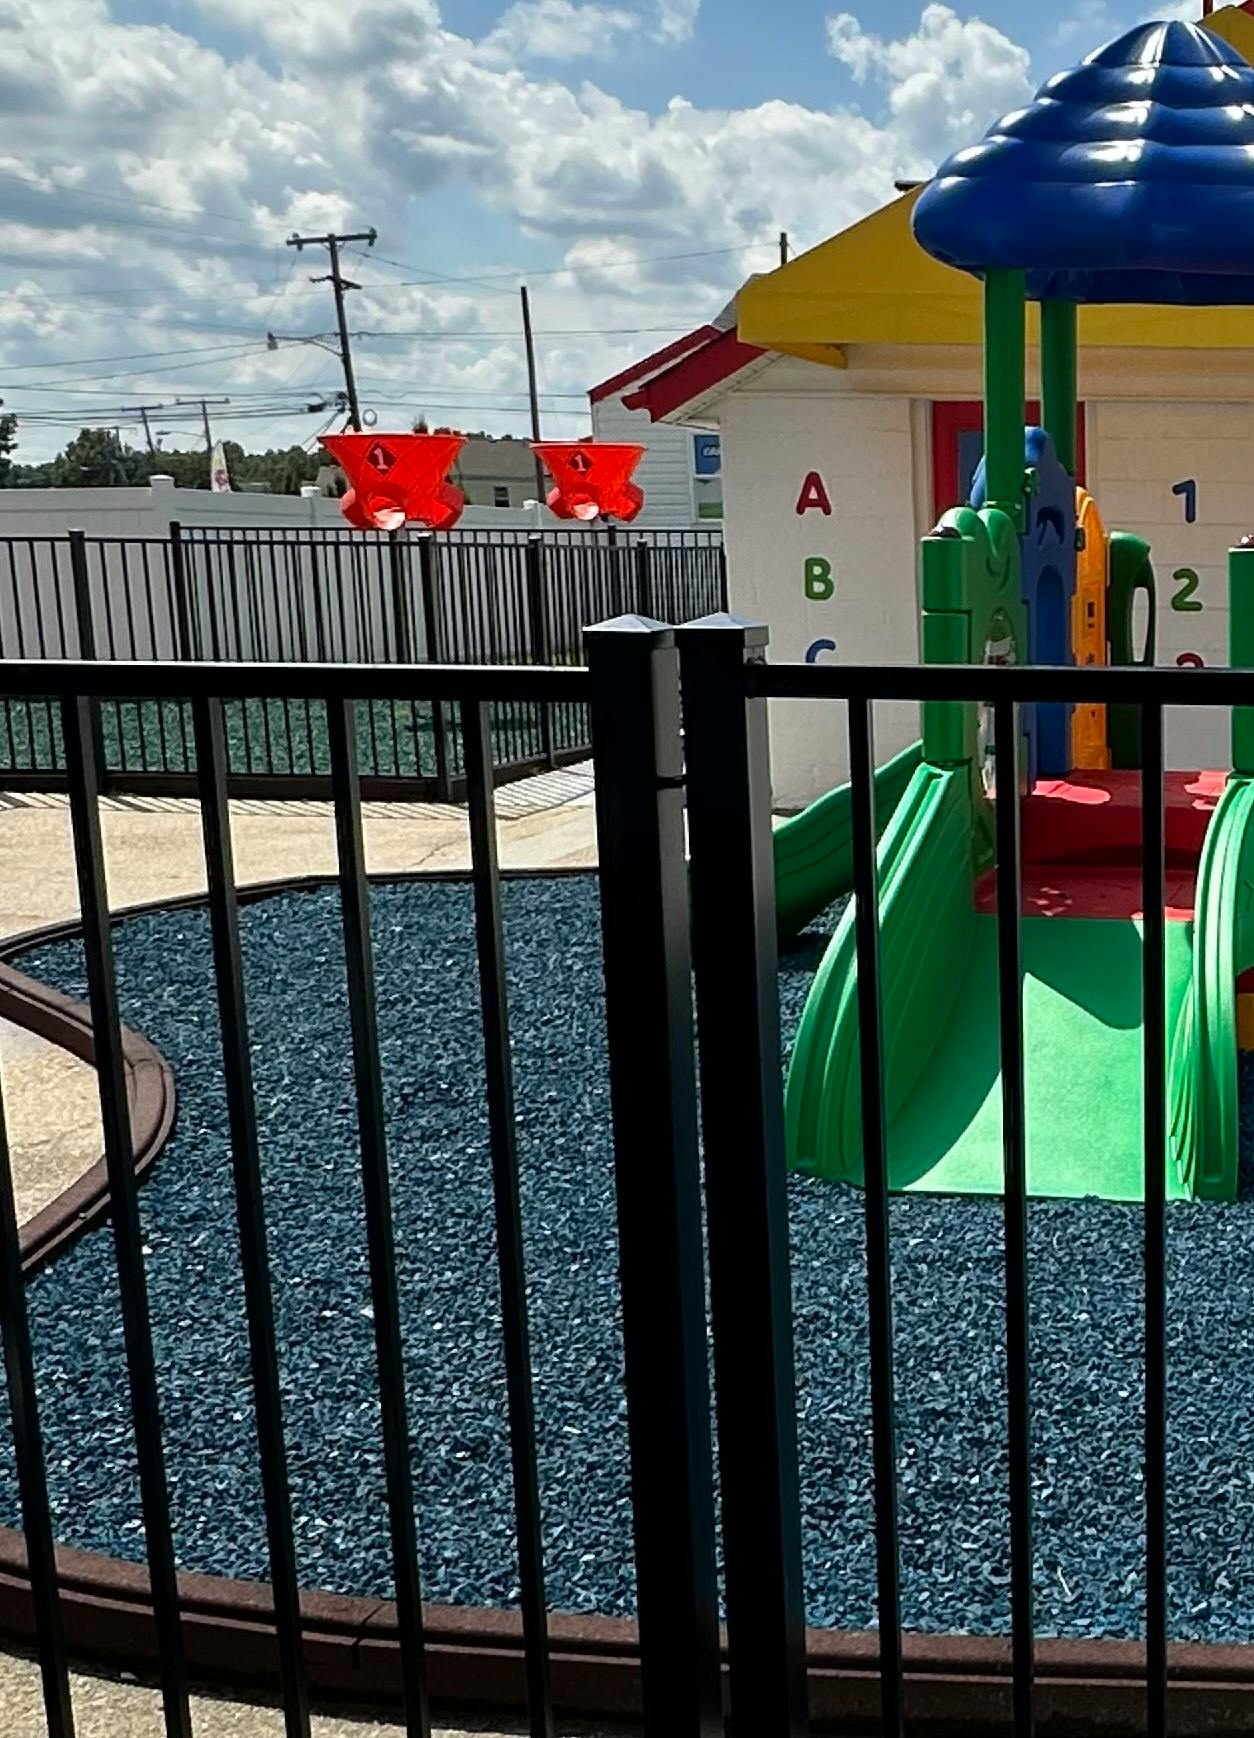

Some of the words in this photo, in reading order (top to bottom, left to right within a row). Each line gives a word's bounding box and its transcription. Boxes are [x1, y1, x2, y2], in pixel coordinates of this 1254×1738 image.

[374, 448, 388, 469] 1
[575, 455, 587, 471] 1
[796, 471, 832, 516] A
[1172, 479, 1196, 524] 1
[804, 557, 834, 601] B
[1171, 568, 1203, 612] 2
